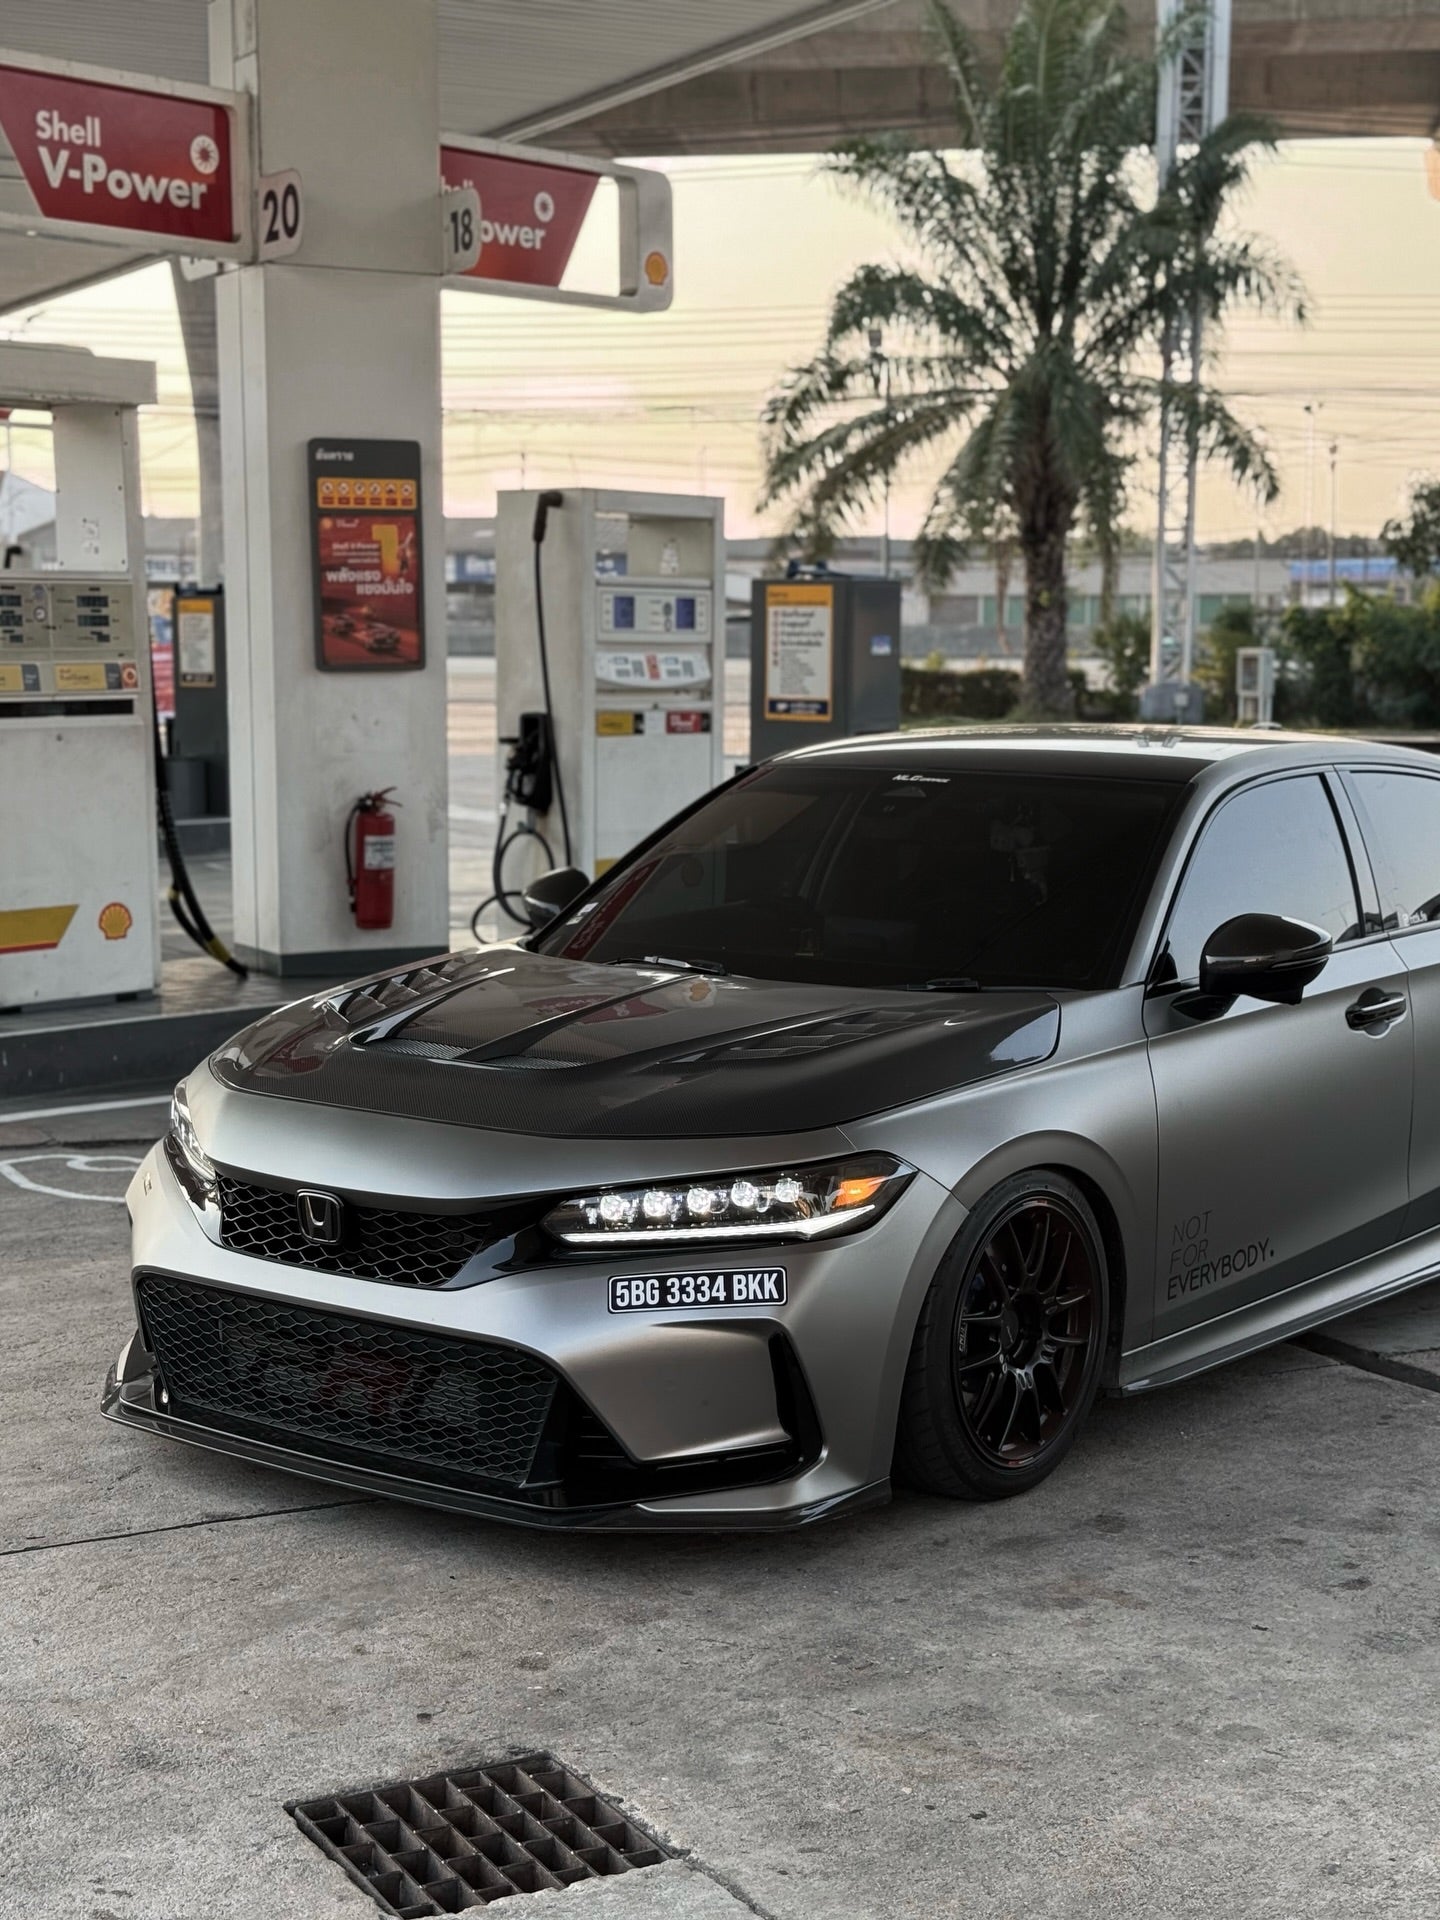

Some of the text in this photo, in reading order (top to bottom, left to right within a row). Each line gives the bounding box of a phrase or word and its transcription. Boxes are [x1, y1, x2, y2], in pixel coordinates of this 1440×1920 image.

[35, 110, 101, 148] Shell
[38, 146, 208, 210] V-Power
[263, 183, 299, 243] 20
[450, 208, 473, 254] 18
[481, 220, 547, 250] ower
[1172, 1209, 1213, 1246] NOT
[1167, 1237, 1274, 1301] EVERYBODY.
[1169, 1238, 1209, 1274] FOR
[616, 1273, 779, 1307] 5BG 3334 BKK
